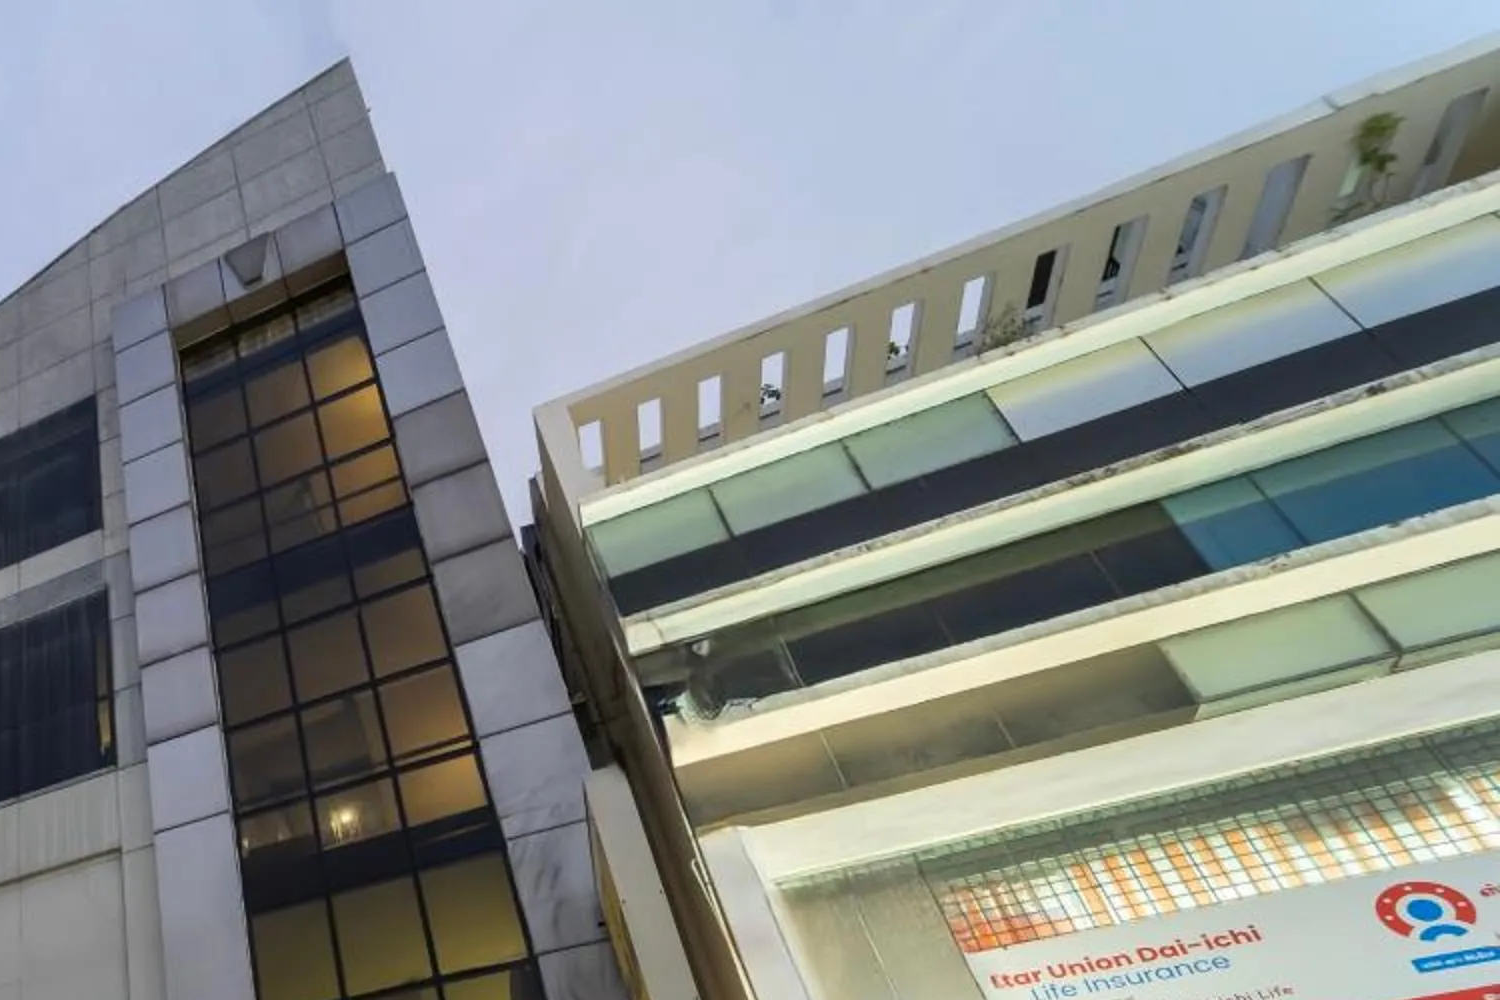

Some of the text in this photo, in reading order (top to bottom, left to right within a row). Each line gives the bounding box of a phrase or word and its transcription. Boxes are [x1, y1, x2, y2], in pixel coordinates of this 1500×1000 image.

[1048, 951, 1133, 981] Union
[1136, 925, 1263, 964] Dai-ichi
[1084, 954, 1231, 994] Insurance
